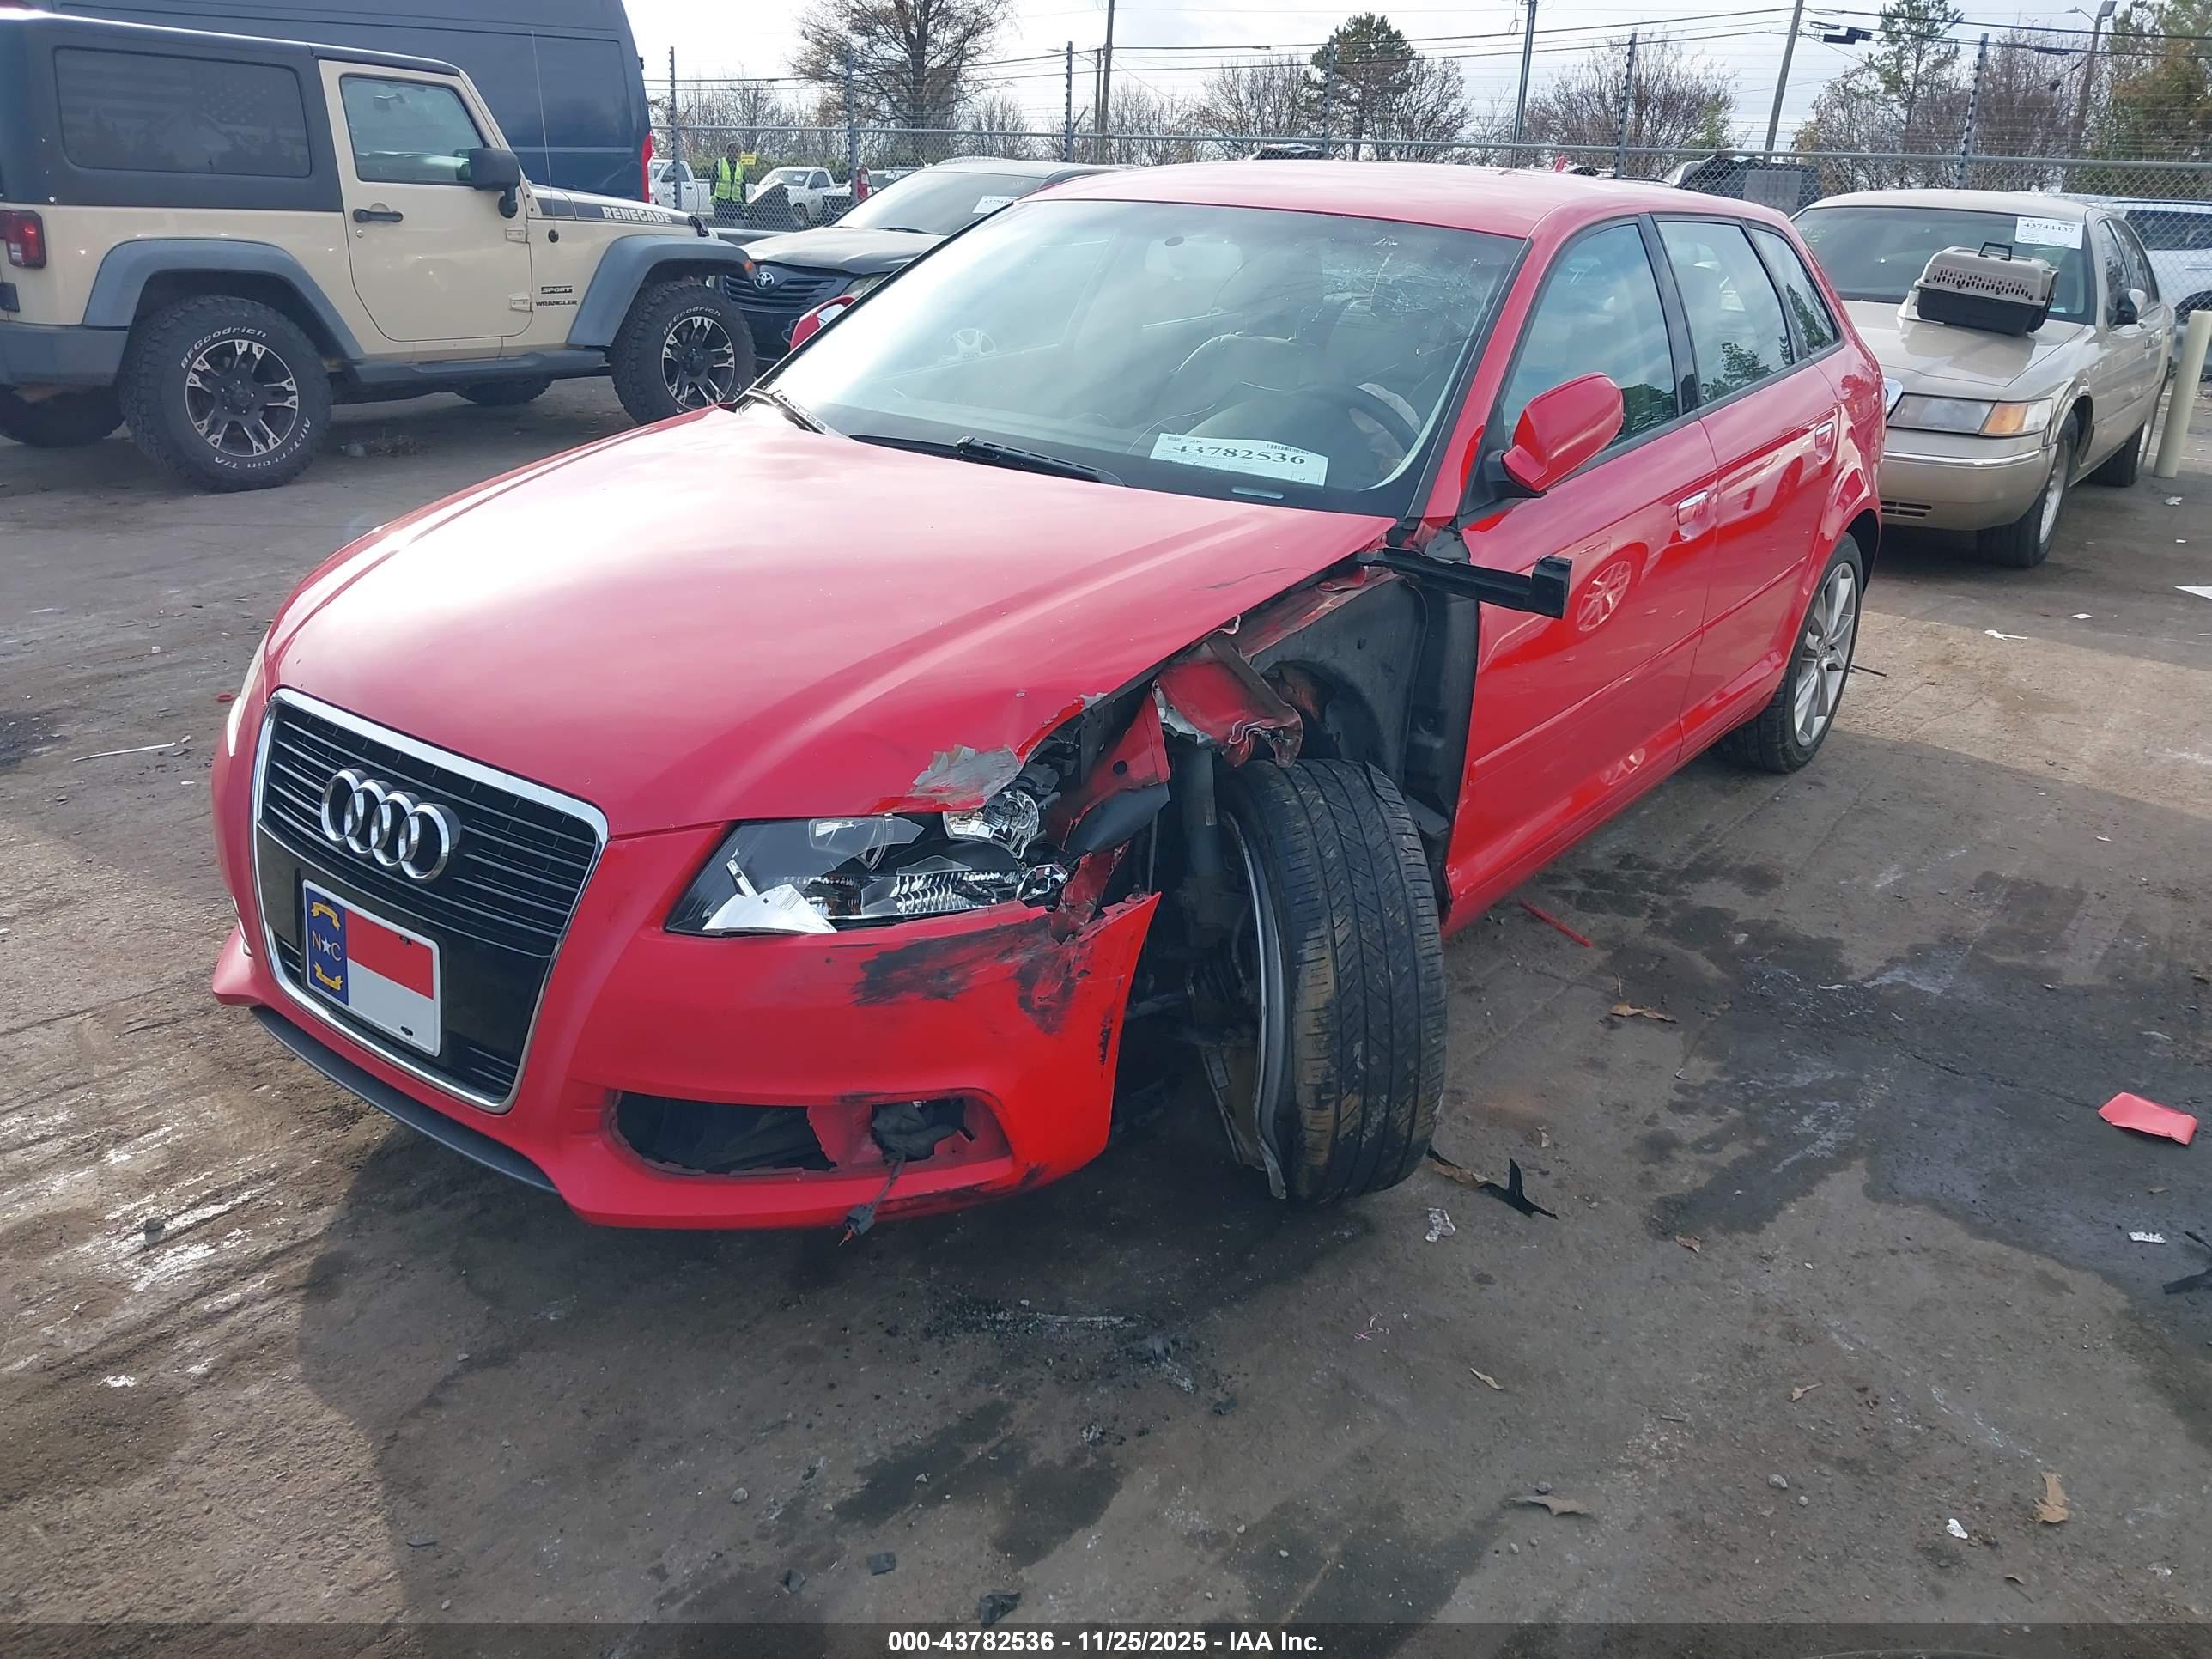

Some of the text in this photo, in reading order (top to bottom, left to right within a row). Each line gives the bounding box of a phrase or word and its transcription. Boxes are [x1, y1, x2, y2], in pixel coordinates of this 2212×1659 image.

[601, 206, 673, 223] RENEGADE
[180, 326, 268, 370] BFGoodrich
[1172, 445, 1306, 465] 43782536
